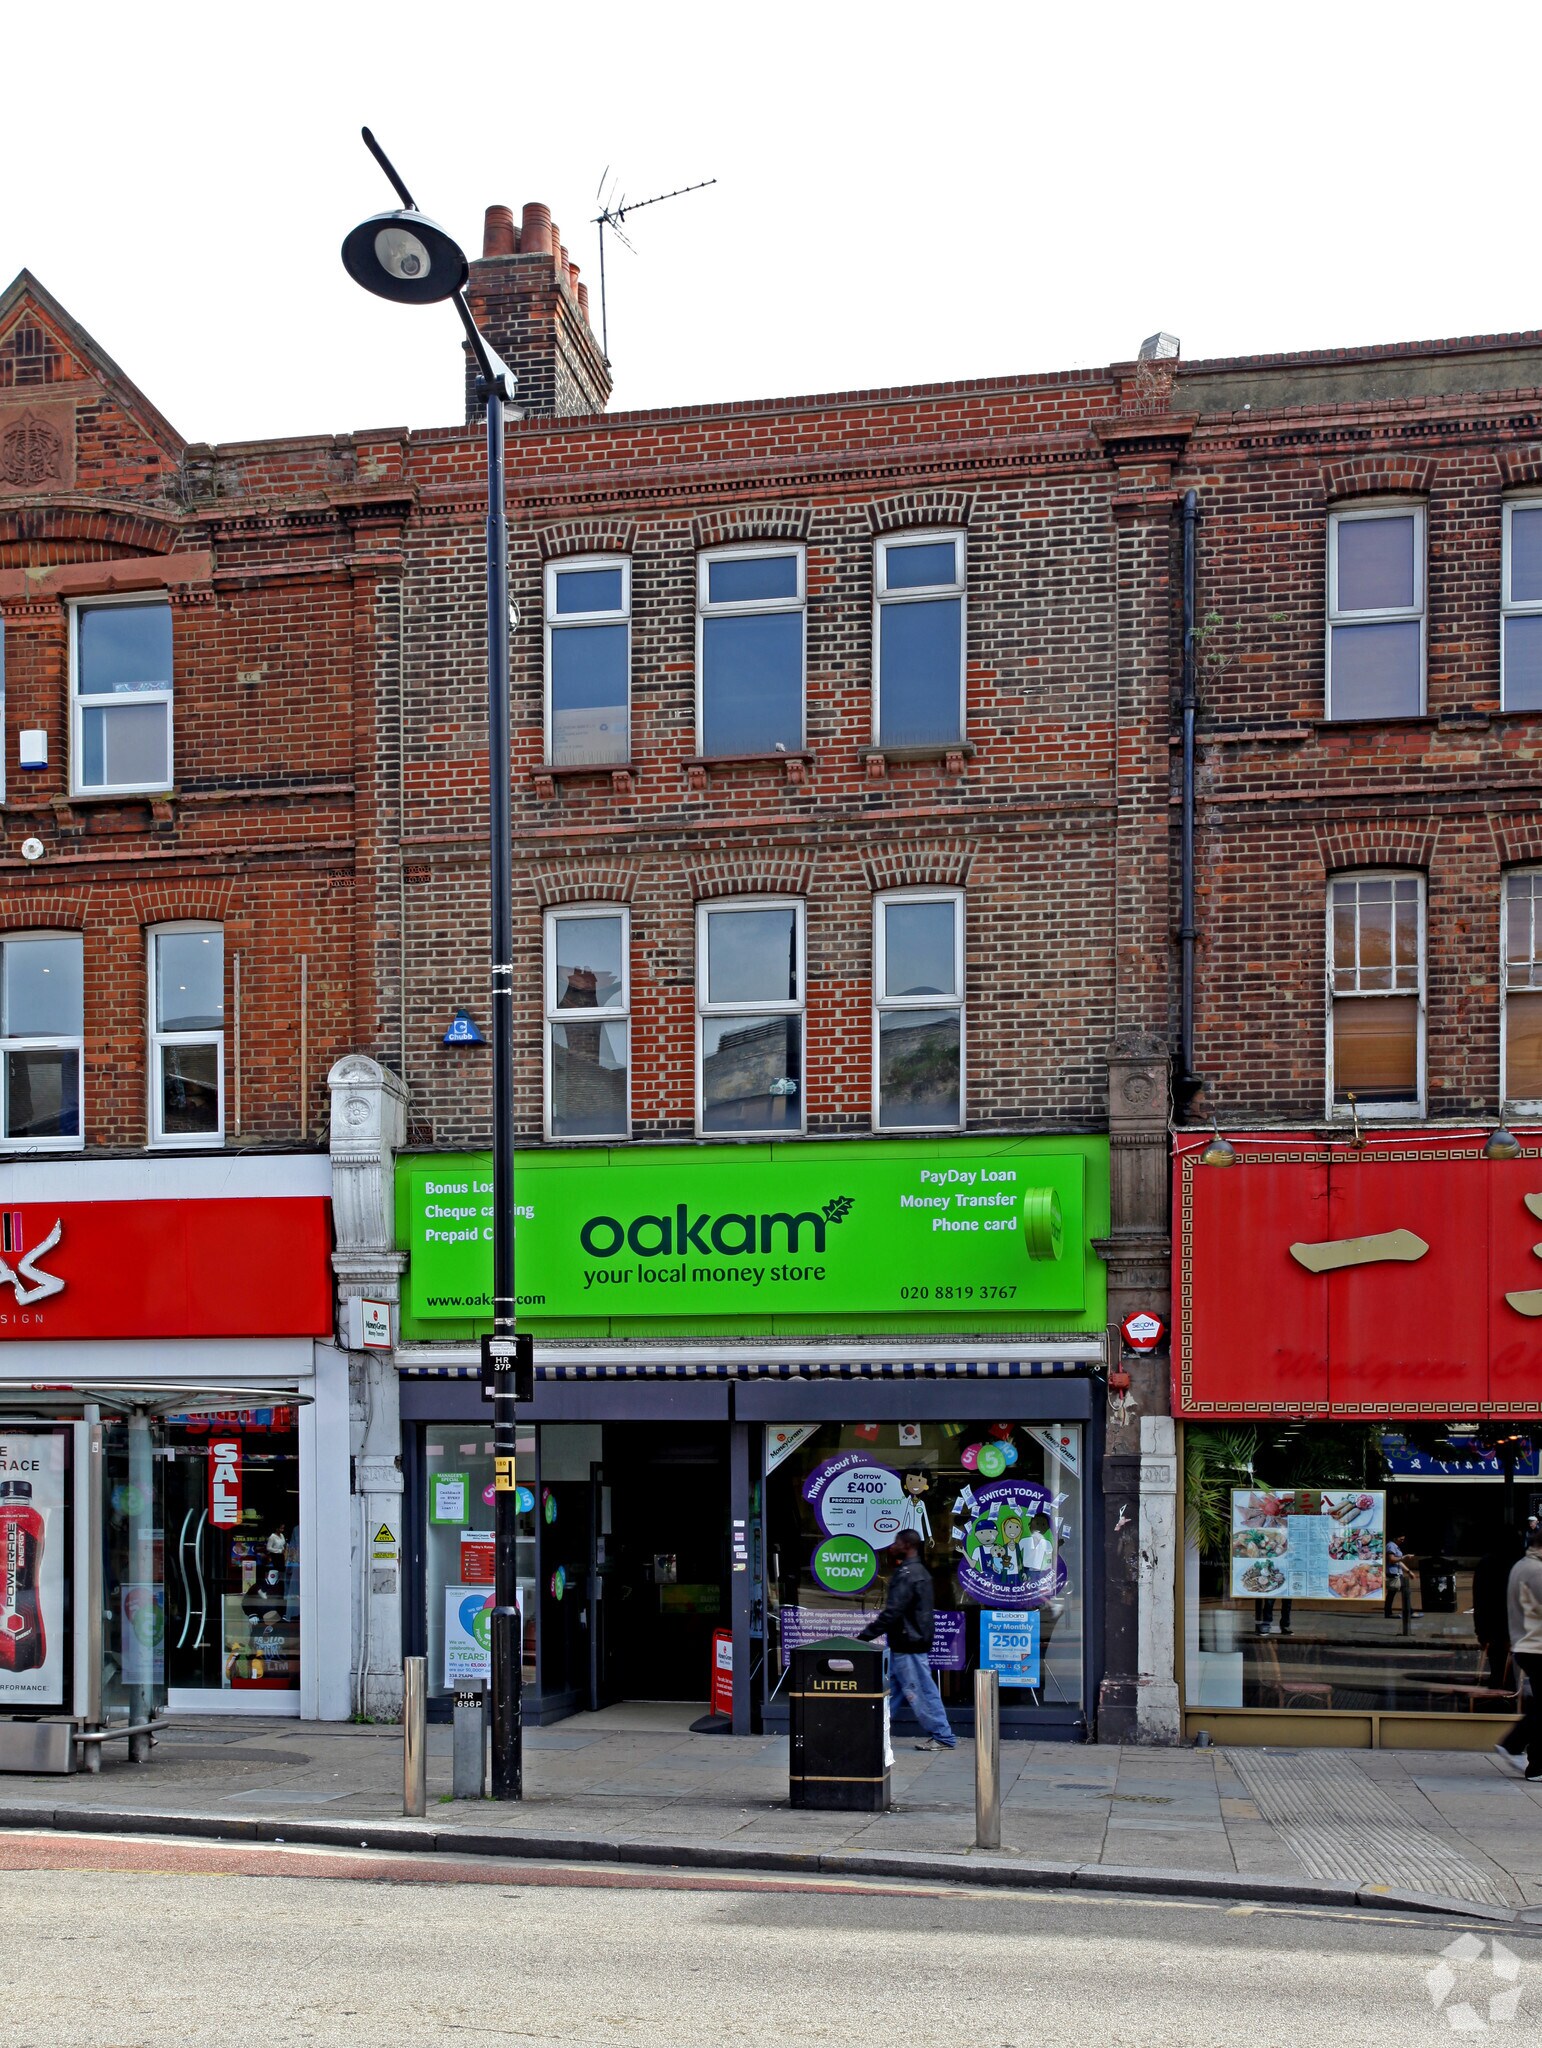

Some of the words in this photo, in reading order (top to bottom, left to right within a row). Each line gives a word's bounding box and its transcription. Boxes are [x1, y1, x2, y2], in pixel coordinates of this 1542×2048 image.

[920, 1170, 977, 1186] PayDay
[981, 1168, 1017, 1182] Loan
[425, 1182, 468, 1195] Bonus
[473, 1181, 495, 1193] Loa
[900, 1195, 950, 1210] Money
[955, 1192, 1017, 1207] Transfer
[425, 1205, 476, 1221] Cheque
[481, 1204, 535, 1219] caing
[580, 1203, 826, 1258] oakam
[932, 1218, 979, 1231] Phone
[984, 1217, 1017, 1231] card
[425, 1227, 478, 1244] Prepaid
[584, 1268, 633, 1289] your
[638, 1263, 686, 1283] local
[692, 1266, 765, 1287] money
[770, 1263, 826, 1281] store
[426, 1293, 546, 1307] www.oaka.com
[900, 1286, 929, 1299] 020
[935, 1286, 973, 1299] 8819
[979, 1285, 1017, 1299] 3767
[770, 1428, 804, 1459] MoneyGram
[1042, 1430, 1076, 1462] MoneyGram
[985, 1451, 998, 1470] 5
[213, 1443, 238, 1522] SALE
[808, 1476, 826, 1499] Think
[824, 1457, 850, 1478] about
[522, 1495, 532, 1506] 5
[979, 1488, 1012, 1504] SWITCH
[1014, 1488, 1044, 1500] TODAY
[6, 1523, 16, 1607] POWERADE
[822, 1552, 868, 1563] SWITCH
[824, 1566, 865, 1578] TODAY
[966, 1568, 979, 1580] ASK
[977, 1577, 991, 1588] FOR
[992, 1583, 1010, 1592] YOUR
[988, 1623, 1001, 1631] Pay
[1003, 1623, 1033, 1631] Monthly
[992, 1635, 1028, 1647] 2500
[814, 1680, 858, 1690] LITTER
